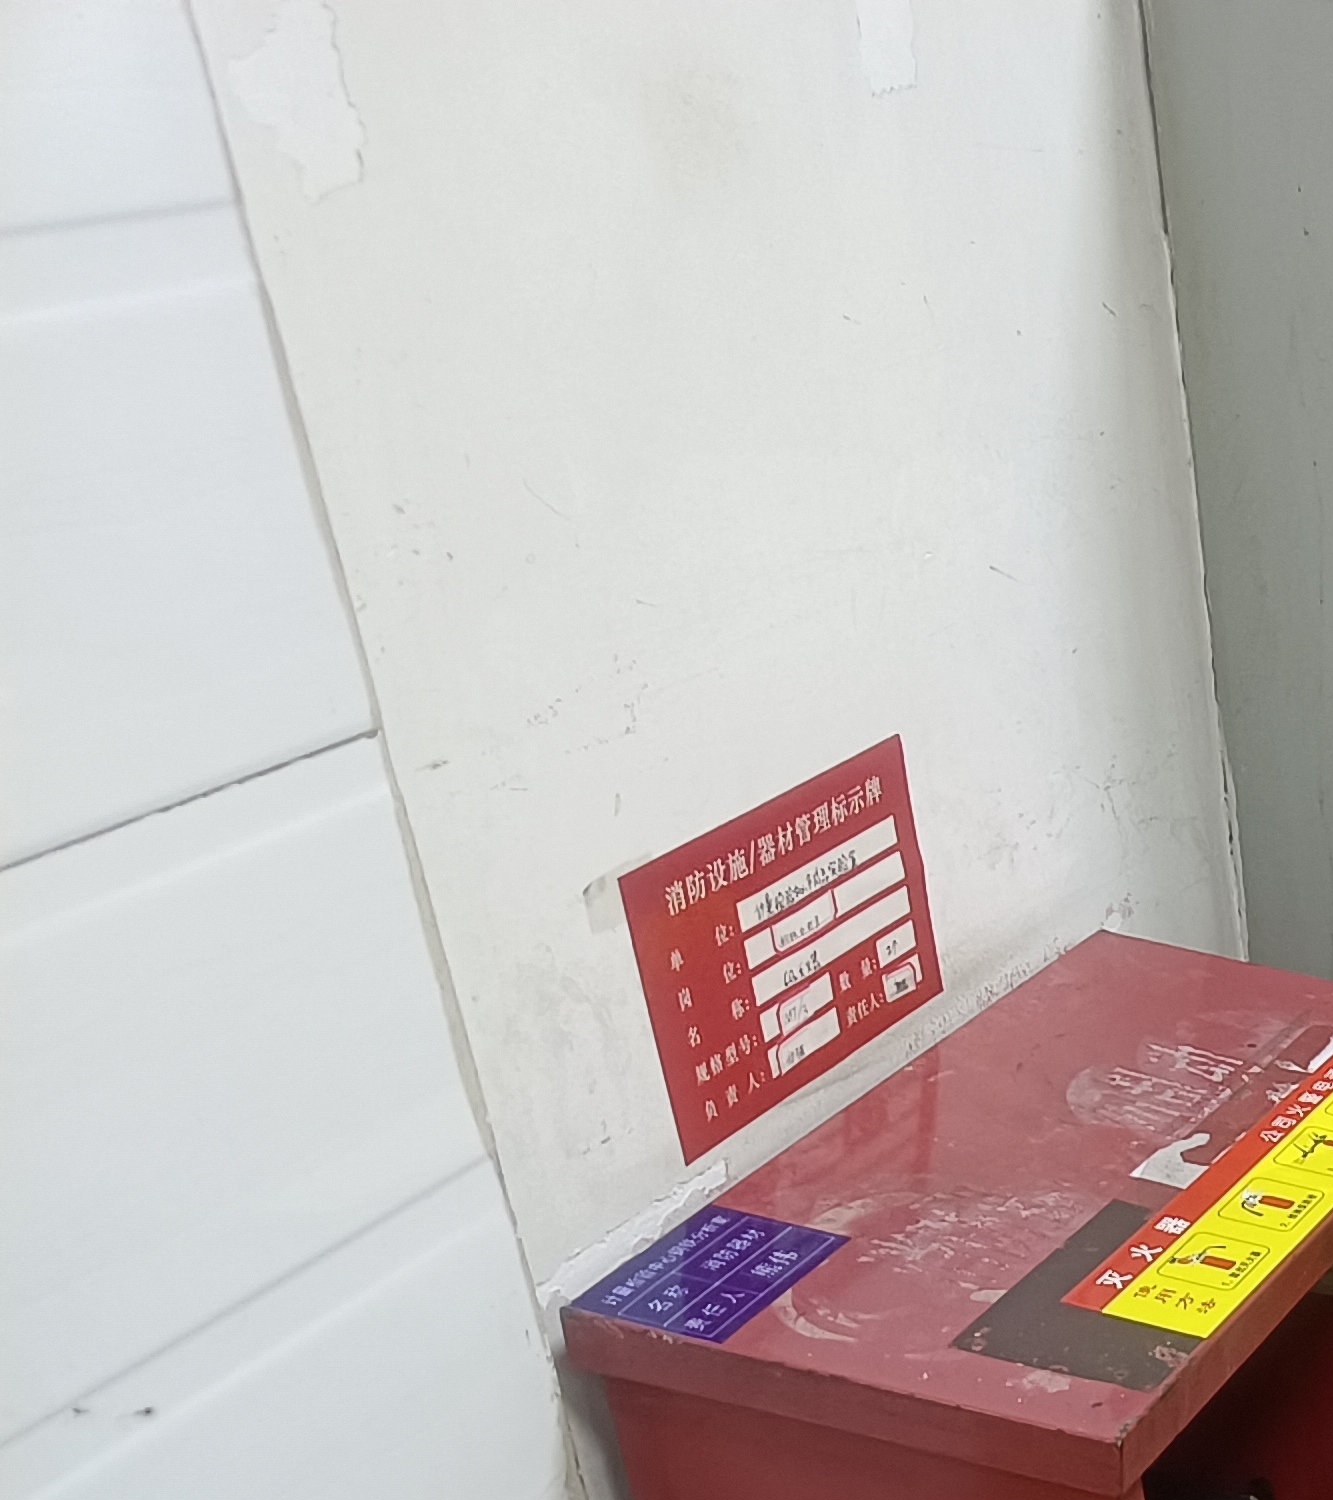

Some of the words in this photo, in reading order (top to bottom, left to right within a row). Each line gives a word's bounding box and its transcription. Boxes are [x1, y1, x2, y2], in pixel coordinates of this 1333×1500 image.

[664, 775, 883, 917] 消防设施/器材管理标示牌
[1095, 1216, 1191, 1289] 灭火器
[684, 1289, 745, 1331] 责任人
[1133, 1285, 1216, 1314] 使用方法
